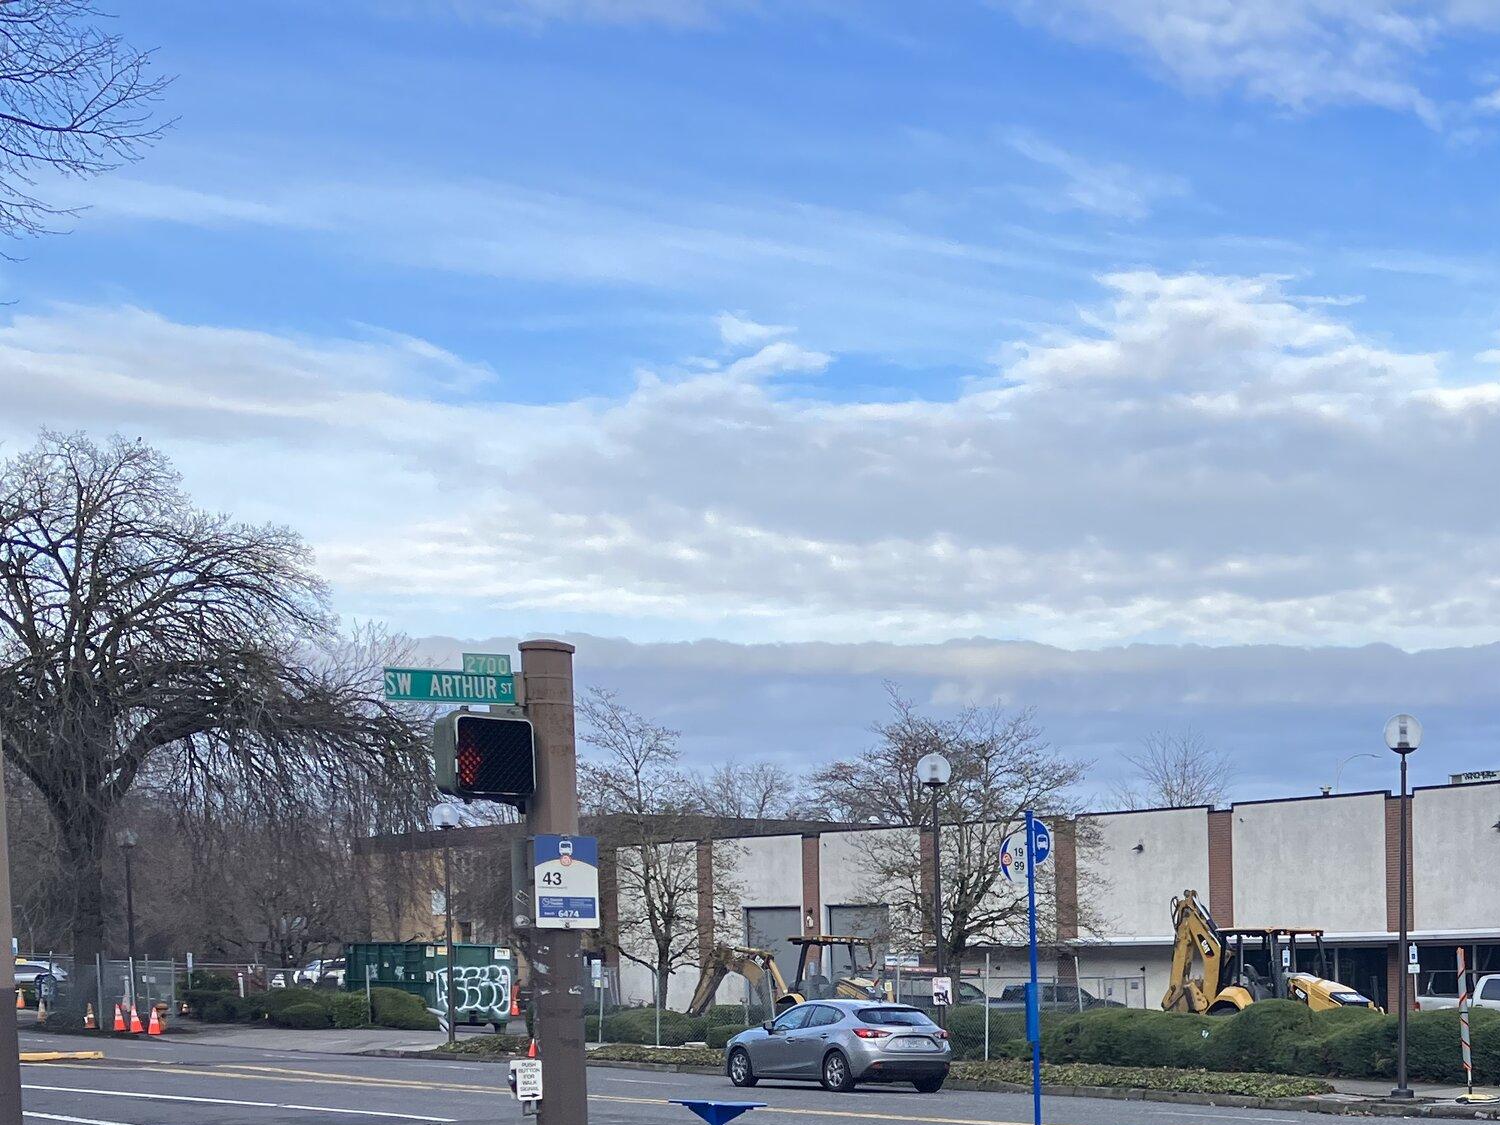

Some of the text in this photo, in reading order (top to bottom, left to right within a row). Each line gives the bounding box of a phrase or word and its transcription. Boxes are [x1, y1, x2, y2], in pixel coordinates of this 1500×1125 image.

[466, 656, 508, 675] 2700
[386, 672, 513, 699] SW ARTHUR ST
[1014, 848, 1024, 857] 19
[1014, 861, 1025, 871] 99
[542, 872, 562, 885] 43
